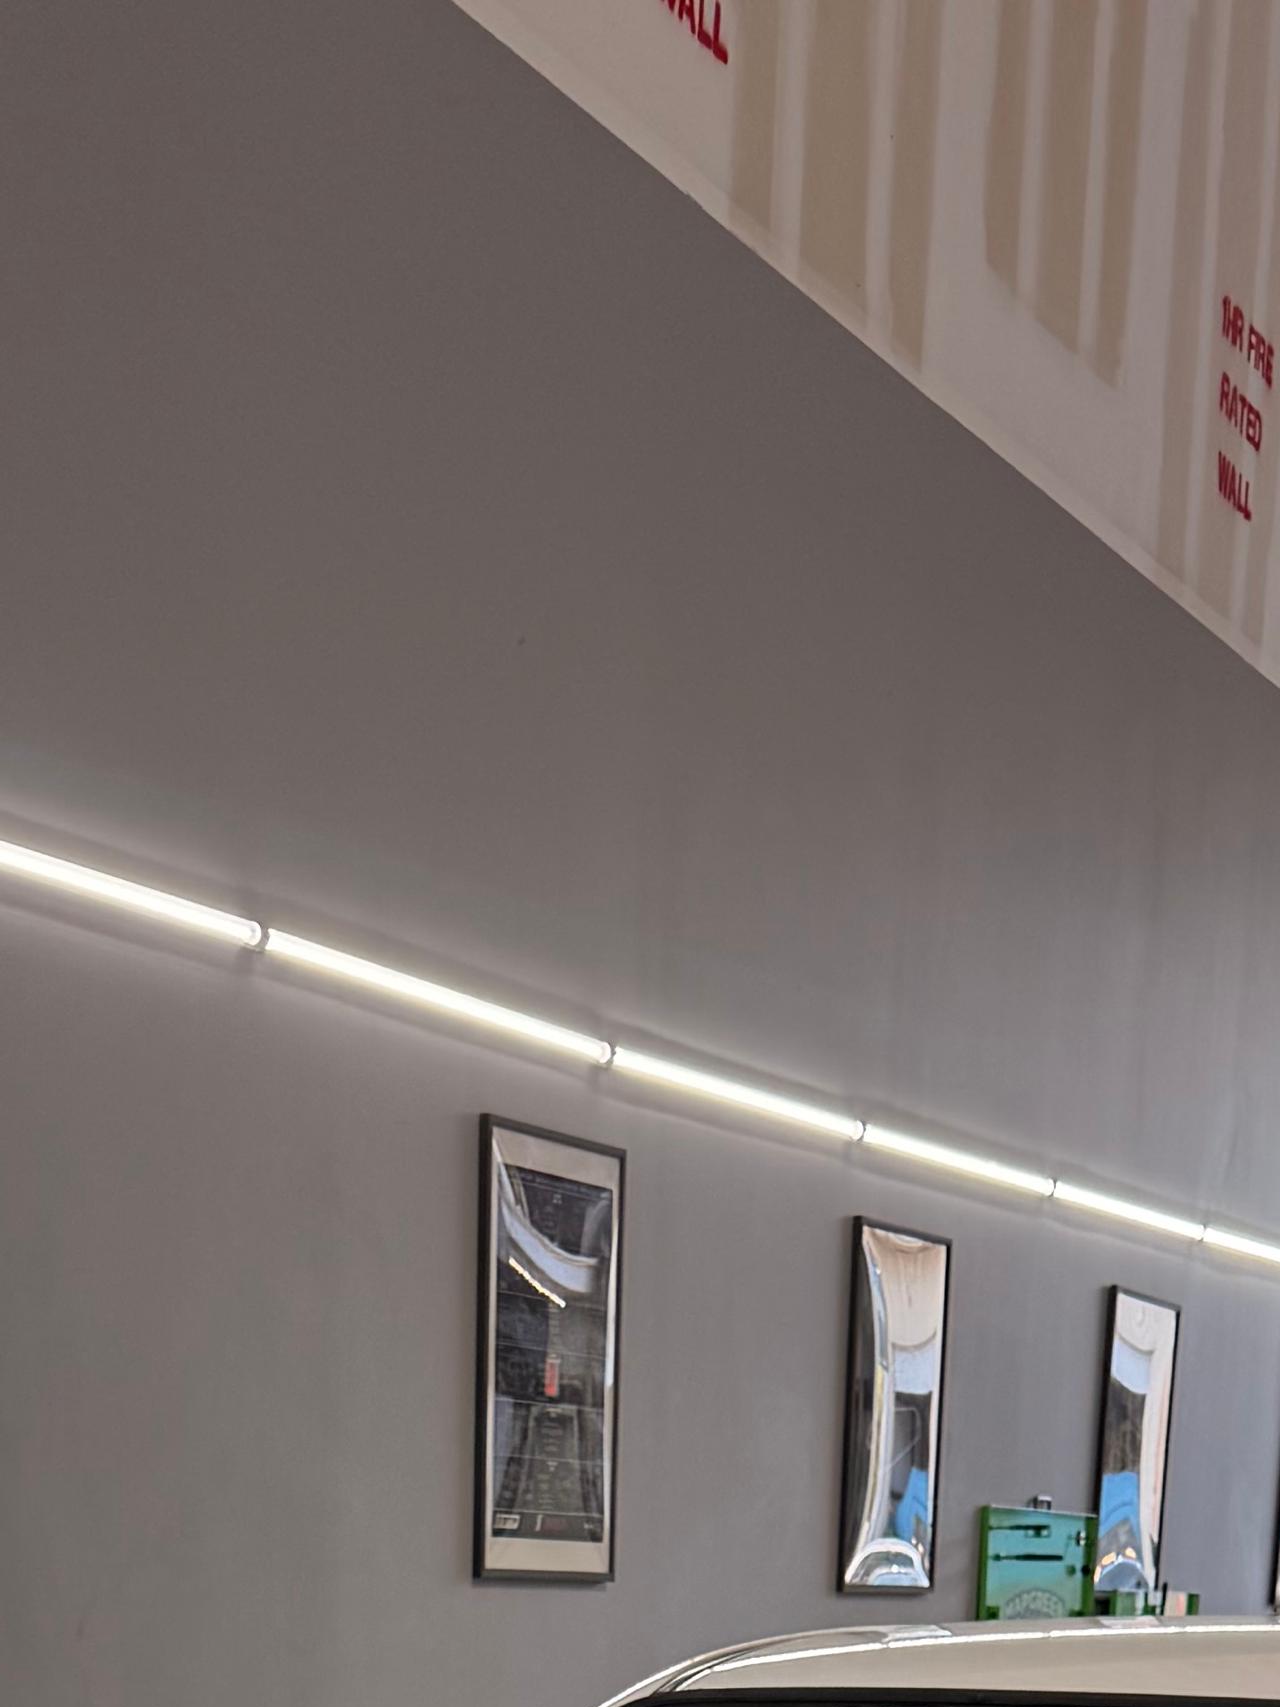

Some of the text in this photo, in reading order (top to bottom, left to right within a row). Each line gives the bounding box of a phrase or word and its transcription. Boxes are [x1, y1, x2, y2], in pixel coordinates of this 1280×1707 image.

[661, 0, 728, 64] ALL
[1247, 324, 1274, 390] FIRE
[1219, 372, 1262, 452] RATED
[1218, 451, 1252, 521] WALL
